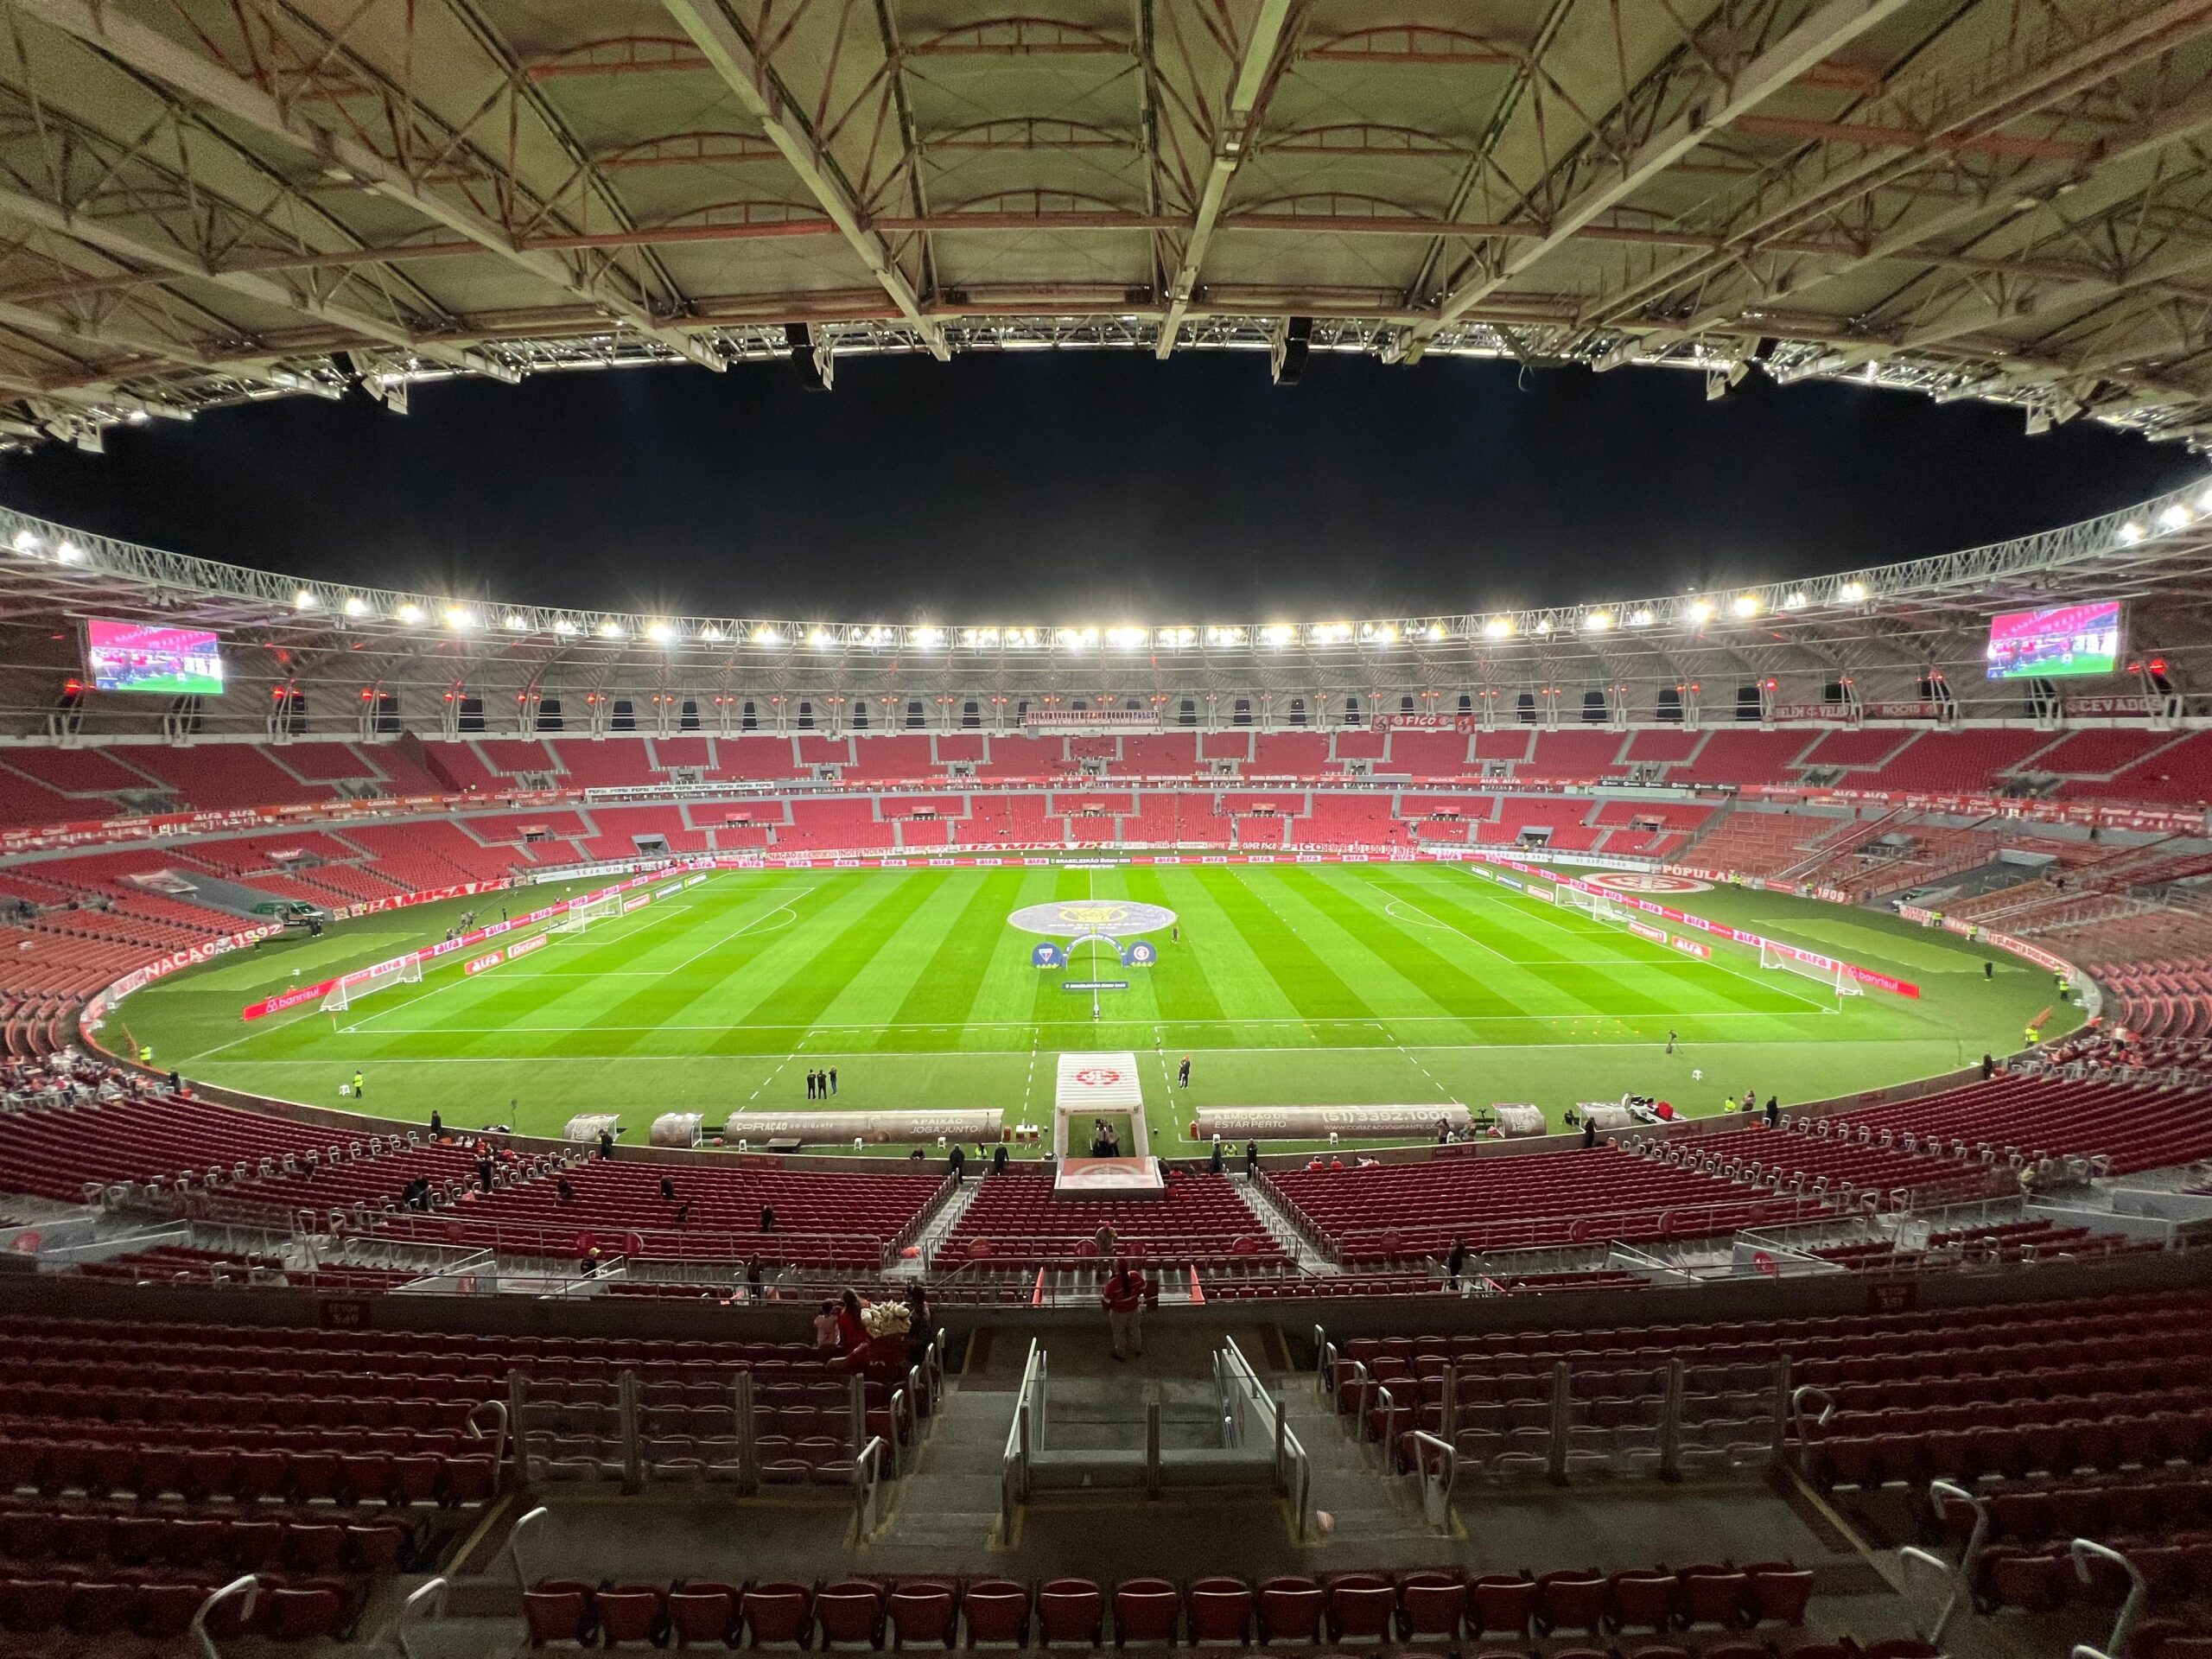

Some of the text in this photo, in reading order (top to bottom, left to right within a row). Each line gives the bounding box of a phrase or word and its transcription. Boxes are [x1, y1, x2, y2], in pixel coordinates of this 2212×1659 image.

[1406, 715, 1437, 725] FICO
[1859, 968, 1897, 990] banrisul
[278, 987, 320, 1007] banrisul
[1322, 1111, 1452, 1122] (51) 3392.1000
[328, 1303, 359, 1313] SETOR
